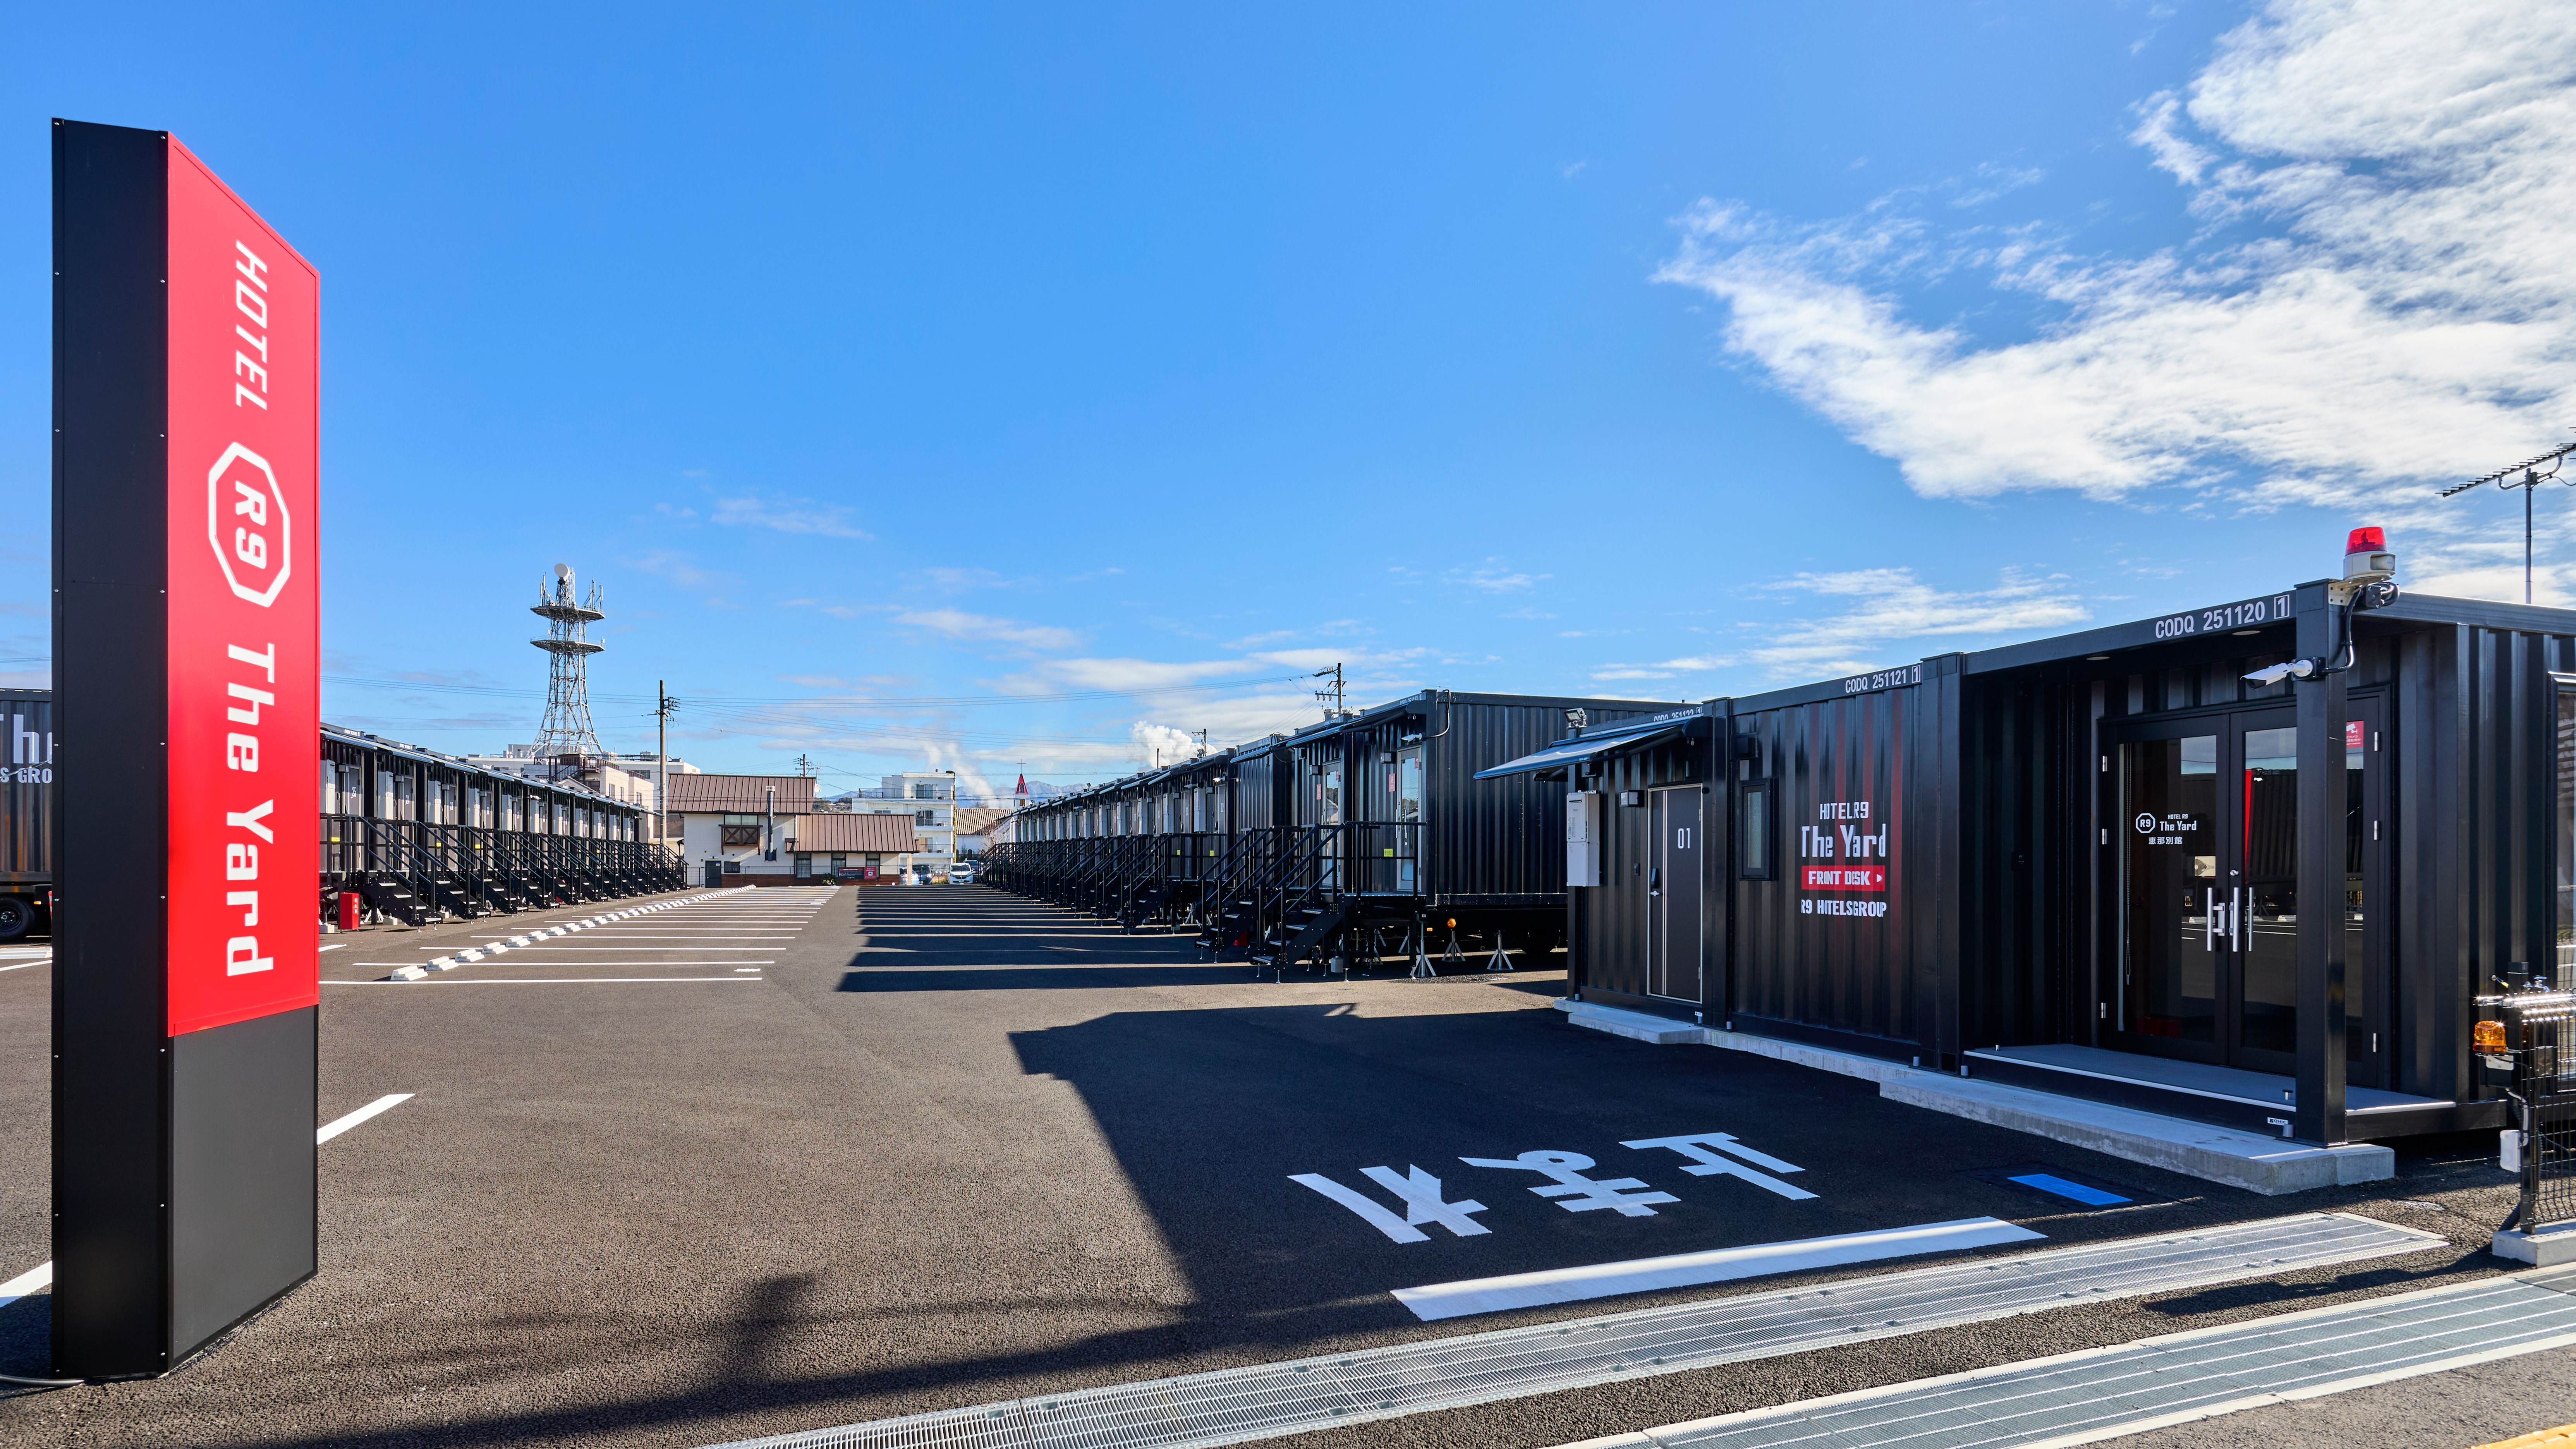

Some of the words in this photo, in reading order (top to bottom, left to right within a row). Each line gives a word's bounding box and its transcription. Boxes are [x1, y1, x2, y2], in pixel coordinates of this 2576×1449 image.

[236, 239, 267, 410] HOTEL
[235, 480, 266, 570] R9
[2155, 615, 2195, 639] CODQ
[2203, 601, 2265, 631] 251120
[1845, 676, 1868, 694] CODQ
[1872, 669, 1906, 689] 251121
[227, 642, 275, 772] The
[17, 767, 52, 784] GRO
[1820, 802, 1853, 820] HOTEL
[1853, 802, 1869, 819] R9
[2140, 819, 2151, 828] R9
[2159, 821, 2175, 831] The
[2177, 820, 2197, 831] Yard
[1678, 828, 1690, 849] 01
[1801, 826, 1834, 857] The
[1839, 823, 1886, 857] Yard
[2148, 836, 2183, 845] 恵那別館
[227, 798, 273, 976] Yard
[1808, 870, 1842, 885] FRONT
[1844, 871, 1870, 886] DESK
[1801, 899, 1813, 914] R9
[1817, 899, 1853, 915] HOTELS
[1853, 900, 1887, 917] GROUP
[1287, 1133, 1820, 1244] 止まれ
